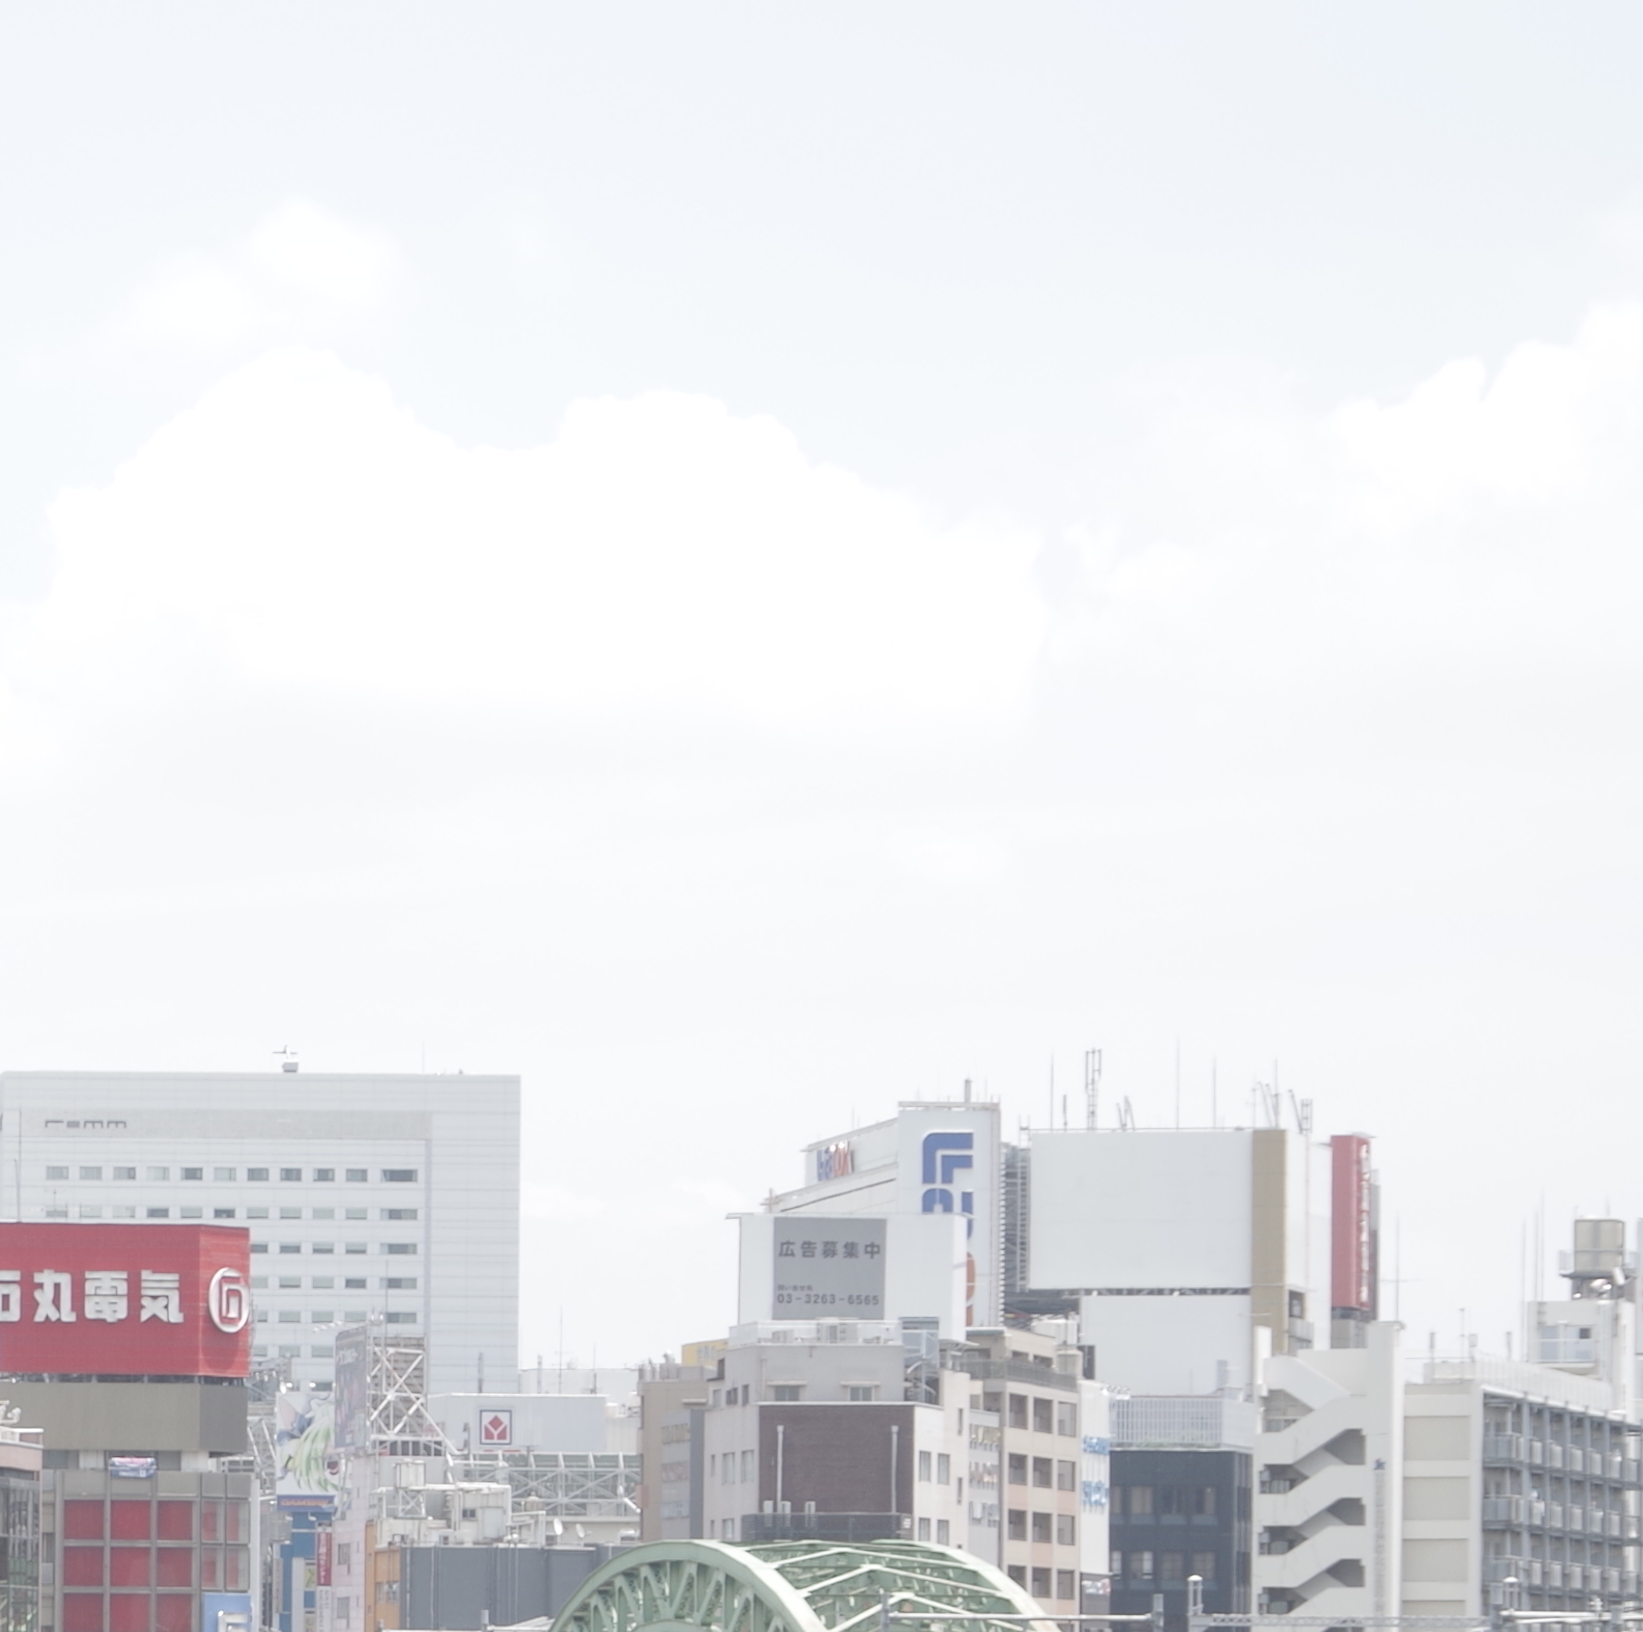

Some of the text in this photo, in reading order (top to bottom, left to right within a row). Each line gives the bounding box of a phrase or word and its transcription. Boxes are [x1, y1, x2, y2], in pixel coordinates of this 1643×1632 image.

[778, 1240, 881, 1260] 広告募集中
